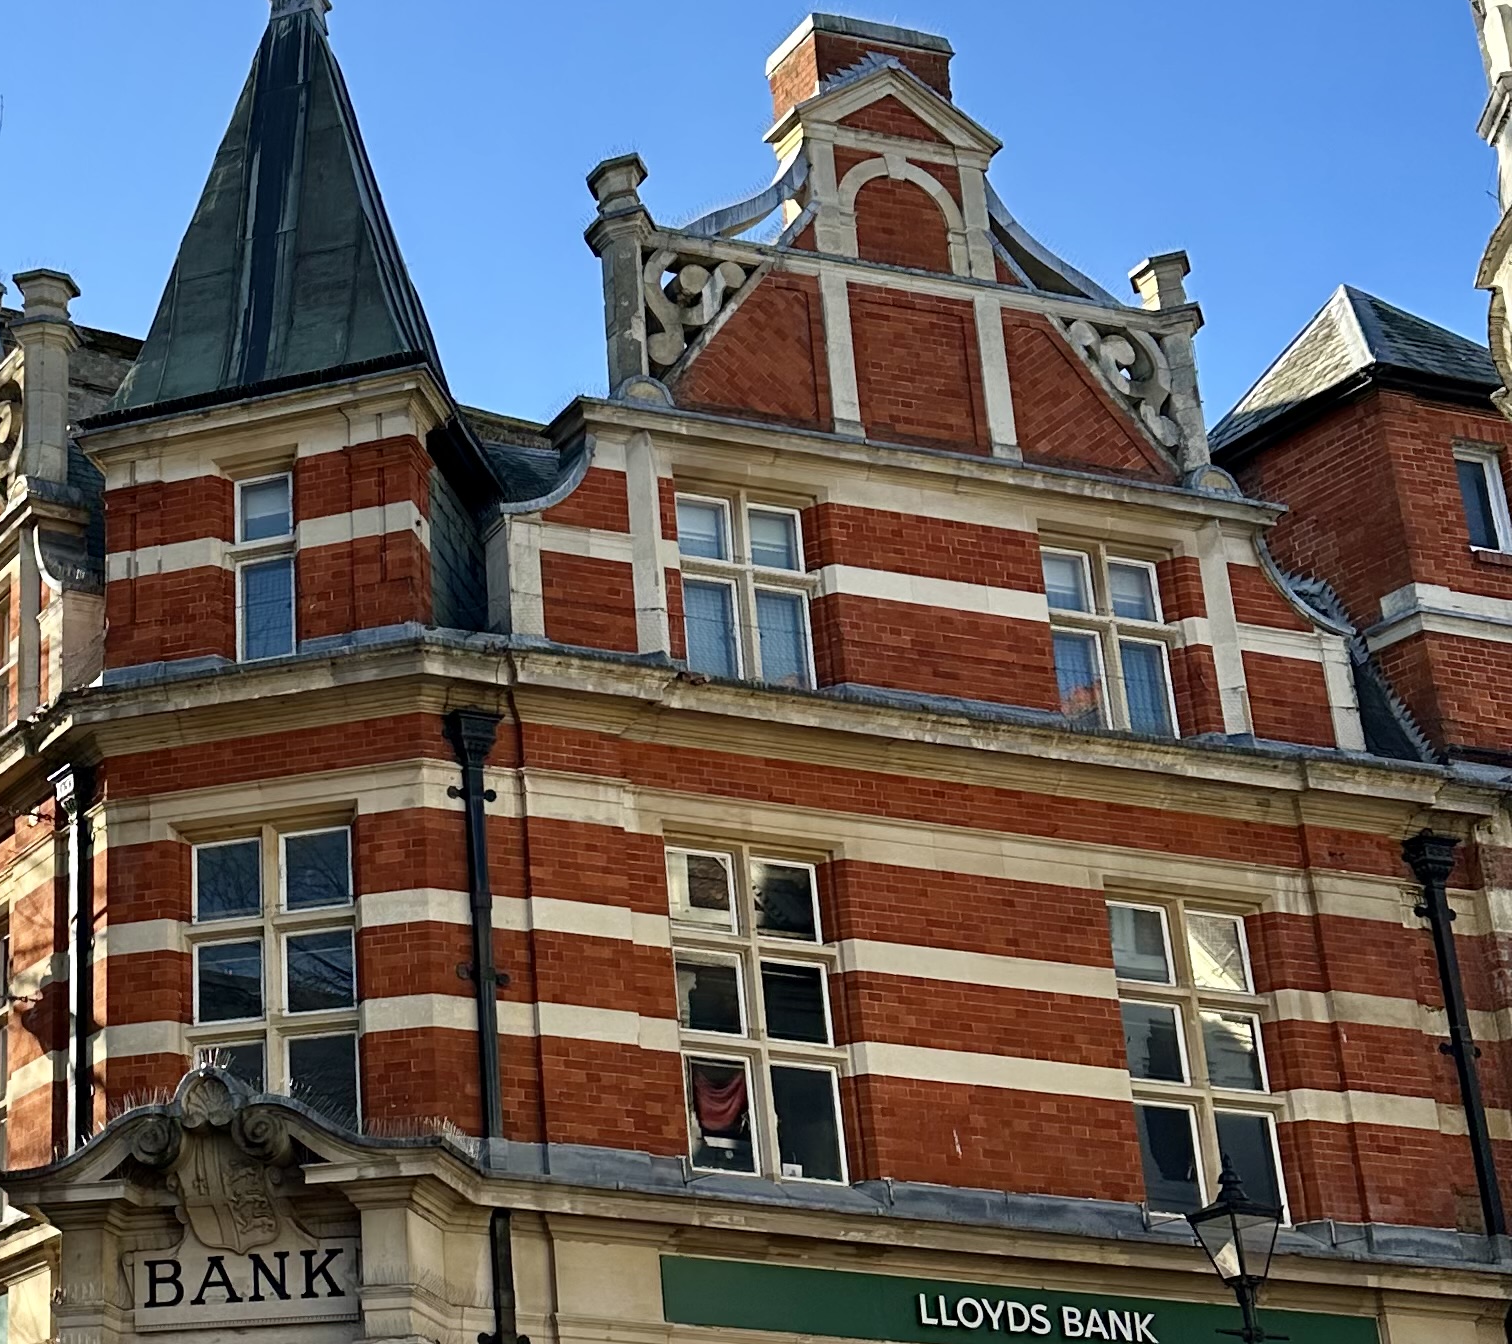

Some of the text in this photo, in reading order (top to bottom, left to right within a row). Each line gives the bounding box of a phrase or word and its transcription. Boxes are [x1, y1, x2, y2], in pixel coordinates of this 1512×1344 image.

[144, 1248, 346, 1308] BANK
[919, 1293, 1160, 1344] LLOYDS BANK
